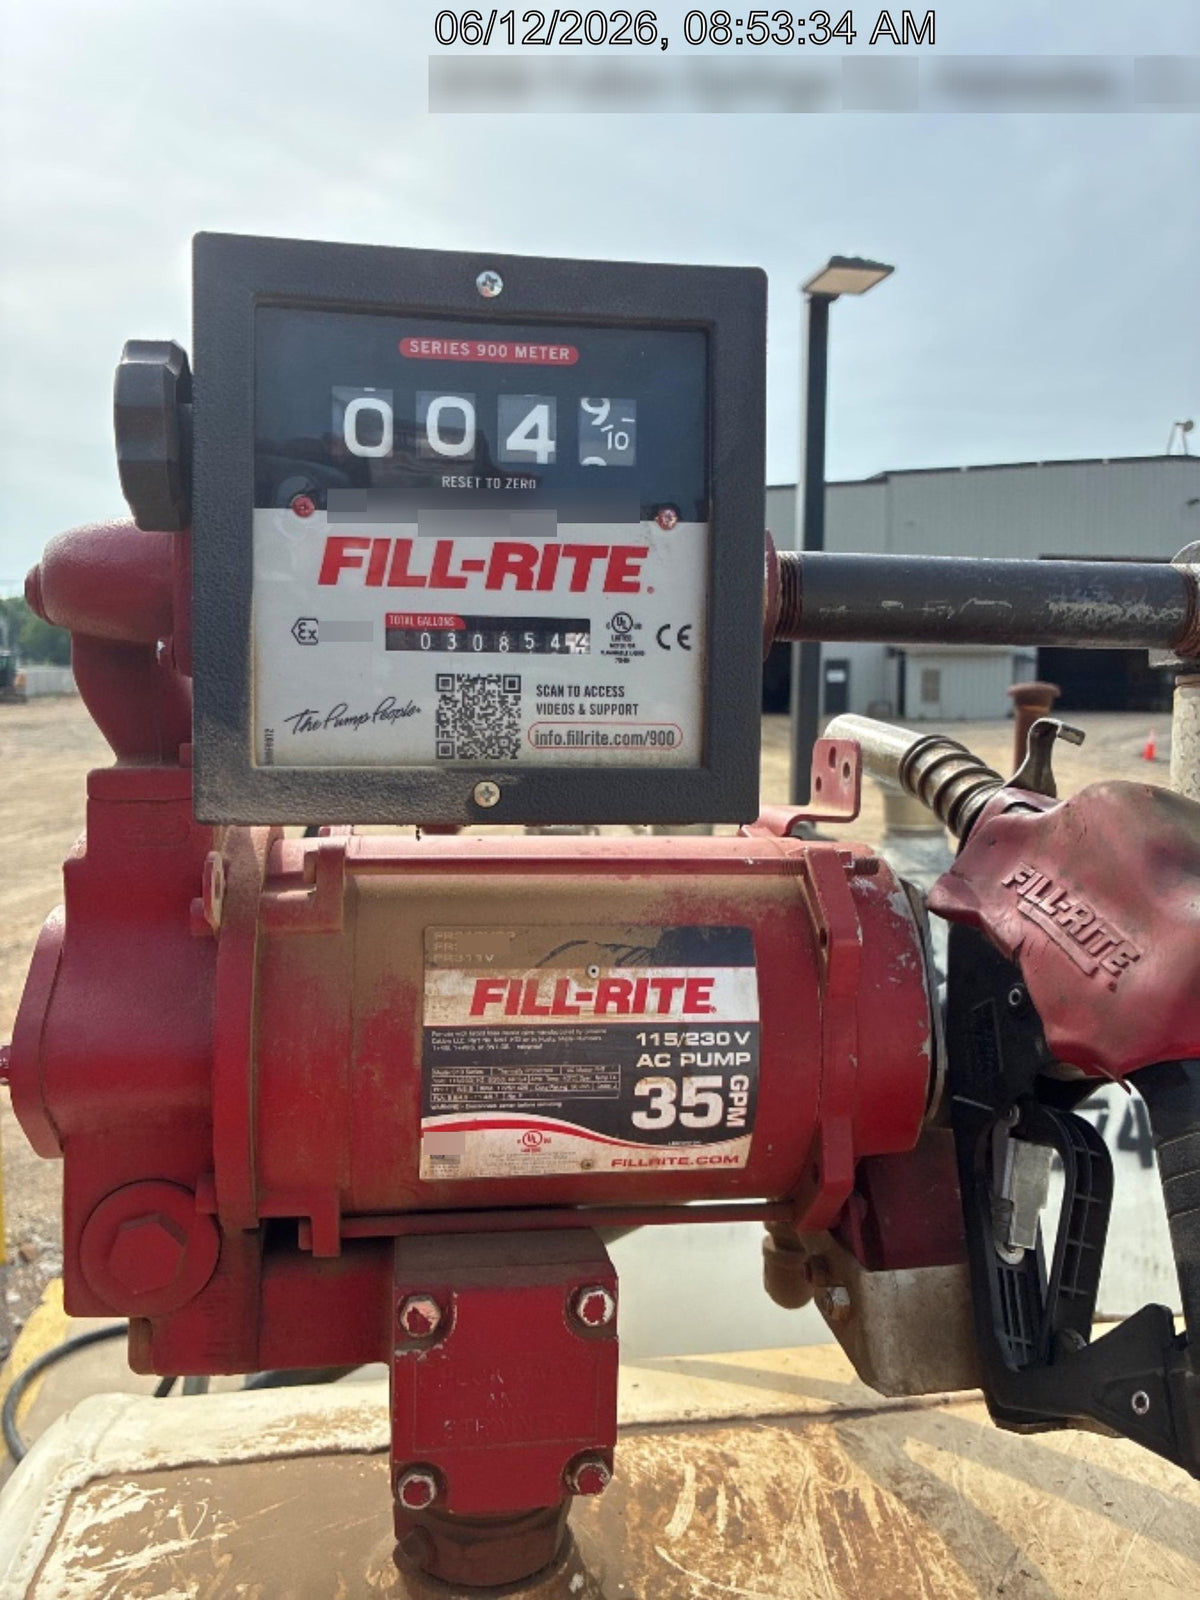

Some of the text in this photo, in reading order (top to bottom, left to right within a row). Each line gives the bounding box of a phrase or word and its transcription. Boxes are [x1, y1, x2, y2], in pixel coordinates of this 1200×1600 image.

[409, 340, 571, 361] SERIES 900 METER
[442, 475, 537, 490] RESET TO ZERO
[388, 614, 455, 628] TOTAL GALLONS
[536, 685, 625, 698] SCAN TO ACCESS
[536, 703, 639, 716] VIDEOS & SUPPORT
[283, 708, 322, 735] The
[323, 702, 371, 731] Pump
[534, 729, 675, 746] info.fillrite.com/900
[635, 1030, 751, 1049] 115/230 V
[636, 1051, 751, 1068] AC PUMP
[631, 1074, 749, 1130] 35 GPM
[610, 1154, 740, 1169] FILLRITE.COM
